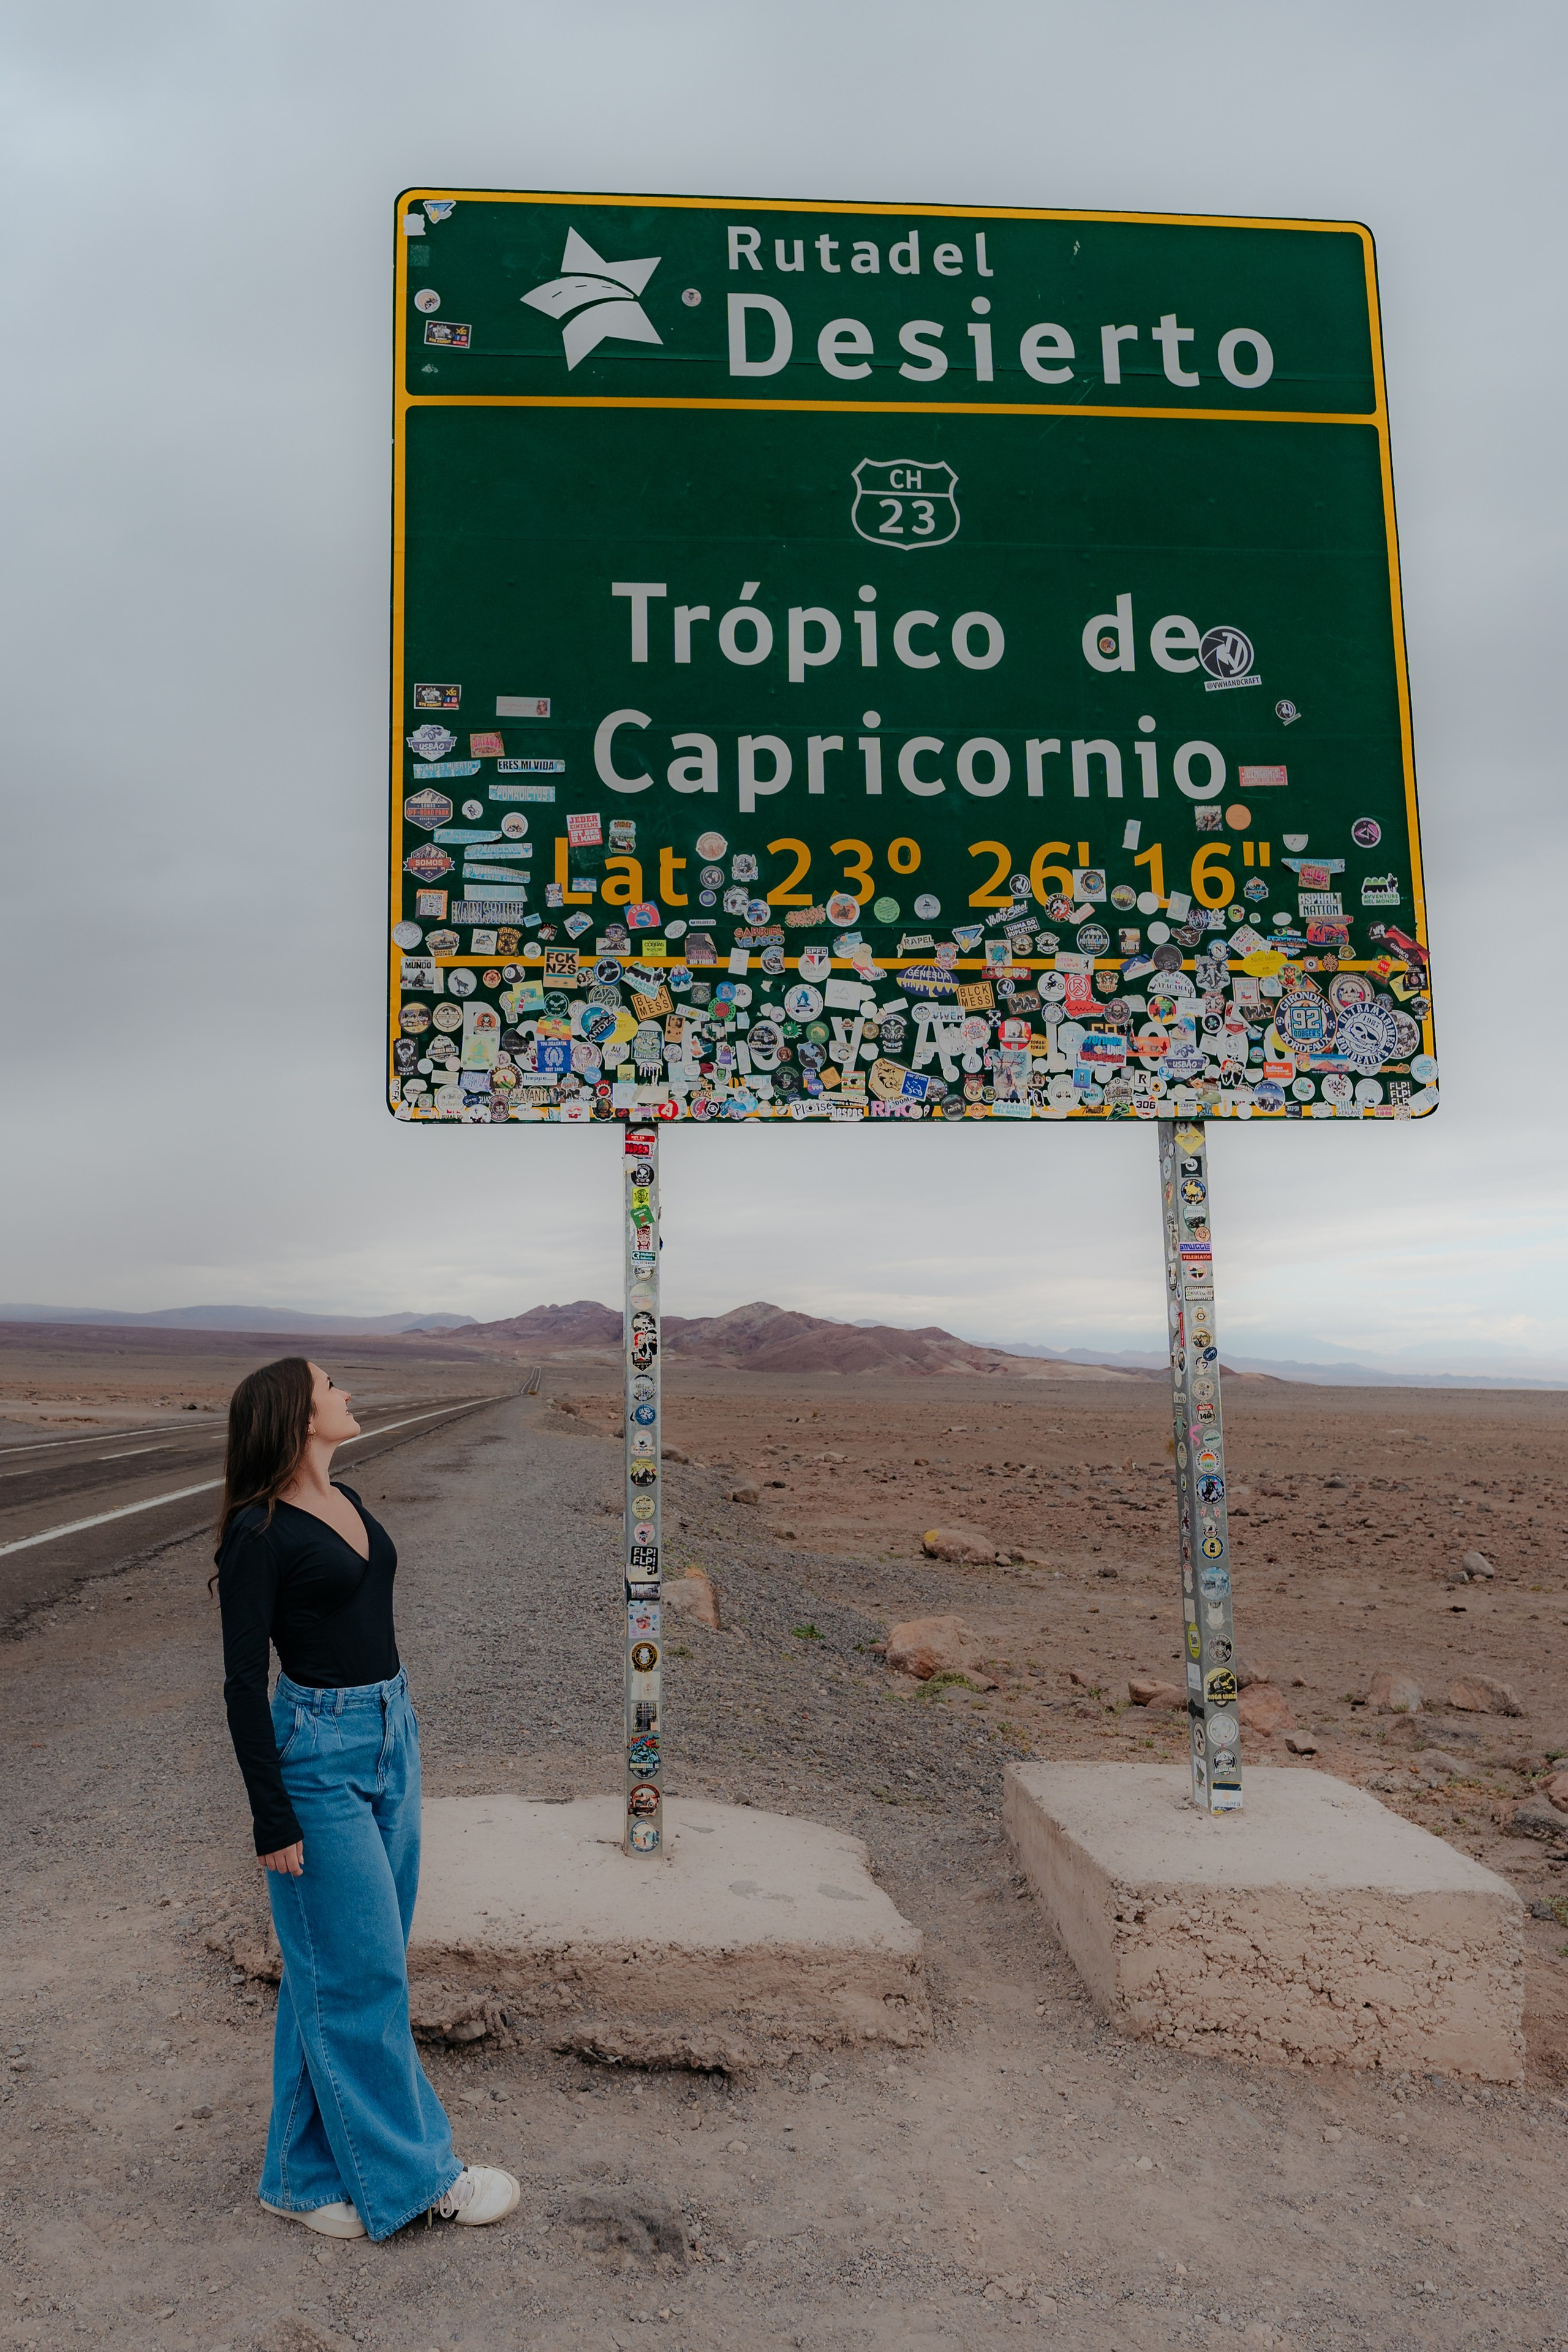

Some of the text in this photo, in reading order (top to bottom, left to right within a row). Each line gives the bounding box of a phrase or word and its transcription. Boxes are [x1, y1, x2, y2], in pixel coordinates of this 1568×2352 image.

[727, 292, 1274, 389] Desierto
[889, 469, 922, 489] CH
[878, 499, 936, 535] 23
[611, 581, 1200, 683] Trópico de
[1206, 677, 1260, 690] @VWHANDCRAFT
[499, 760, 554, 771] ERES MI VIDA
[594, 709, 1226, 813] Capricornio
[570, 815, 598, 824] JEDER
[555, 837, 688, 906] Lat
[1298, 892, 1342, 904] ASPHALT
[630, 905, 650, 914] UEFA
[1303, 905, 1339, 916] NATION
[734, 925, 785, 938] GABRIEL
[1005, 921, 1025, 932] TURMA
[1006, 924, 1038, 937] SUPLETIVO
[734, 935, 785, 948] VELASCO
[903, 937, 934, 945] RAPEL
[546, 952, 576, 963] FCK
[546, 963, 576, 974] NZS
[907, 969, 951, 980] GENESUR
[623, 974, 658, 993] AVVENTURE
[1157, 982, 1188, 992] ATACAMA
[633, 984, 656, 998] MONDO
[960, 985, 989, 997] BLCK
[639, 999, 669, 1016] MESS
[961, 995, 992, 1008] MESS
[1279, 991, 1332, 1014] GIRONDINS
[1292, 1009, 1321, 1030] 92
[1338, 1003, 1396, 1048] ULTRAMARINES
[1362, 1015, 1380, 1028] 1987
[588, 1014, 617, 1041] ANDES
[1280, 1033, 1332, 1053] BORDEAUX
[1338, 1036, 1384, 1065] BORDEAUX
[1172, 1059, 1197, 1068] USBÃO
[1138, 1074, 1147, 1084] R
[1136, 1101, 1156, 1109] 306
[633, 1547, 656, 1556] FLP!
[632, 1556, 656, 1565] FLP!
